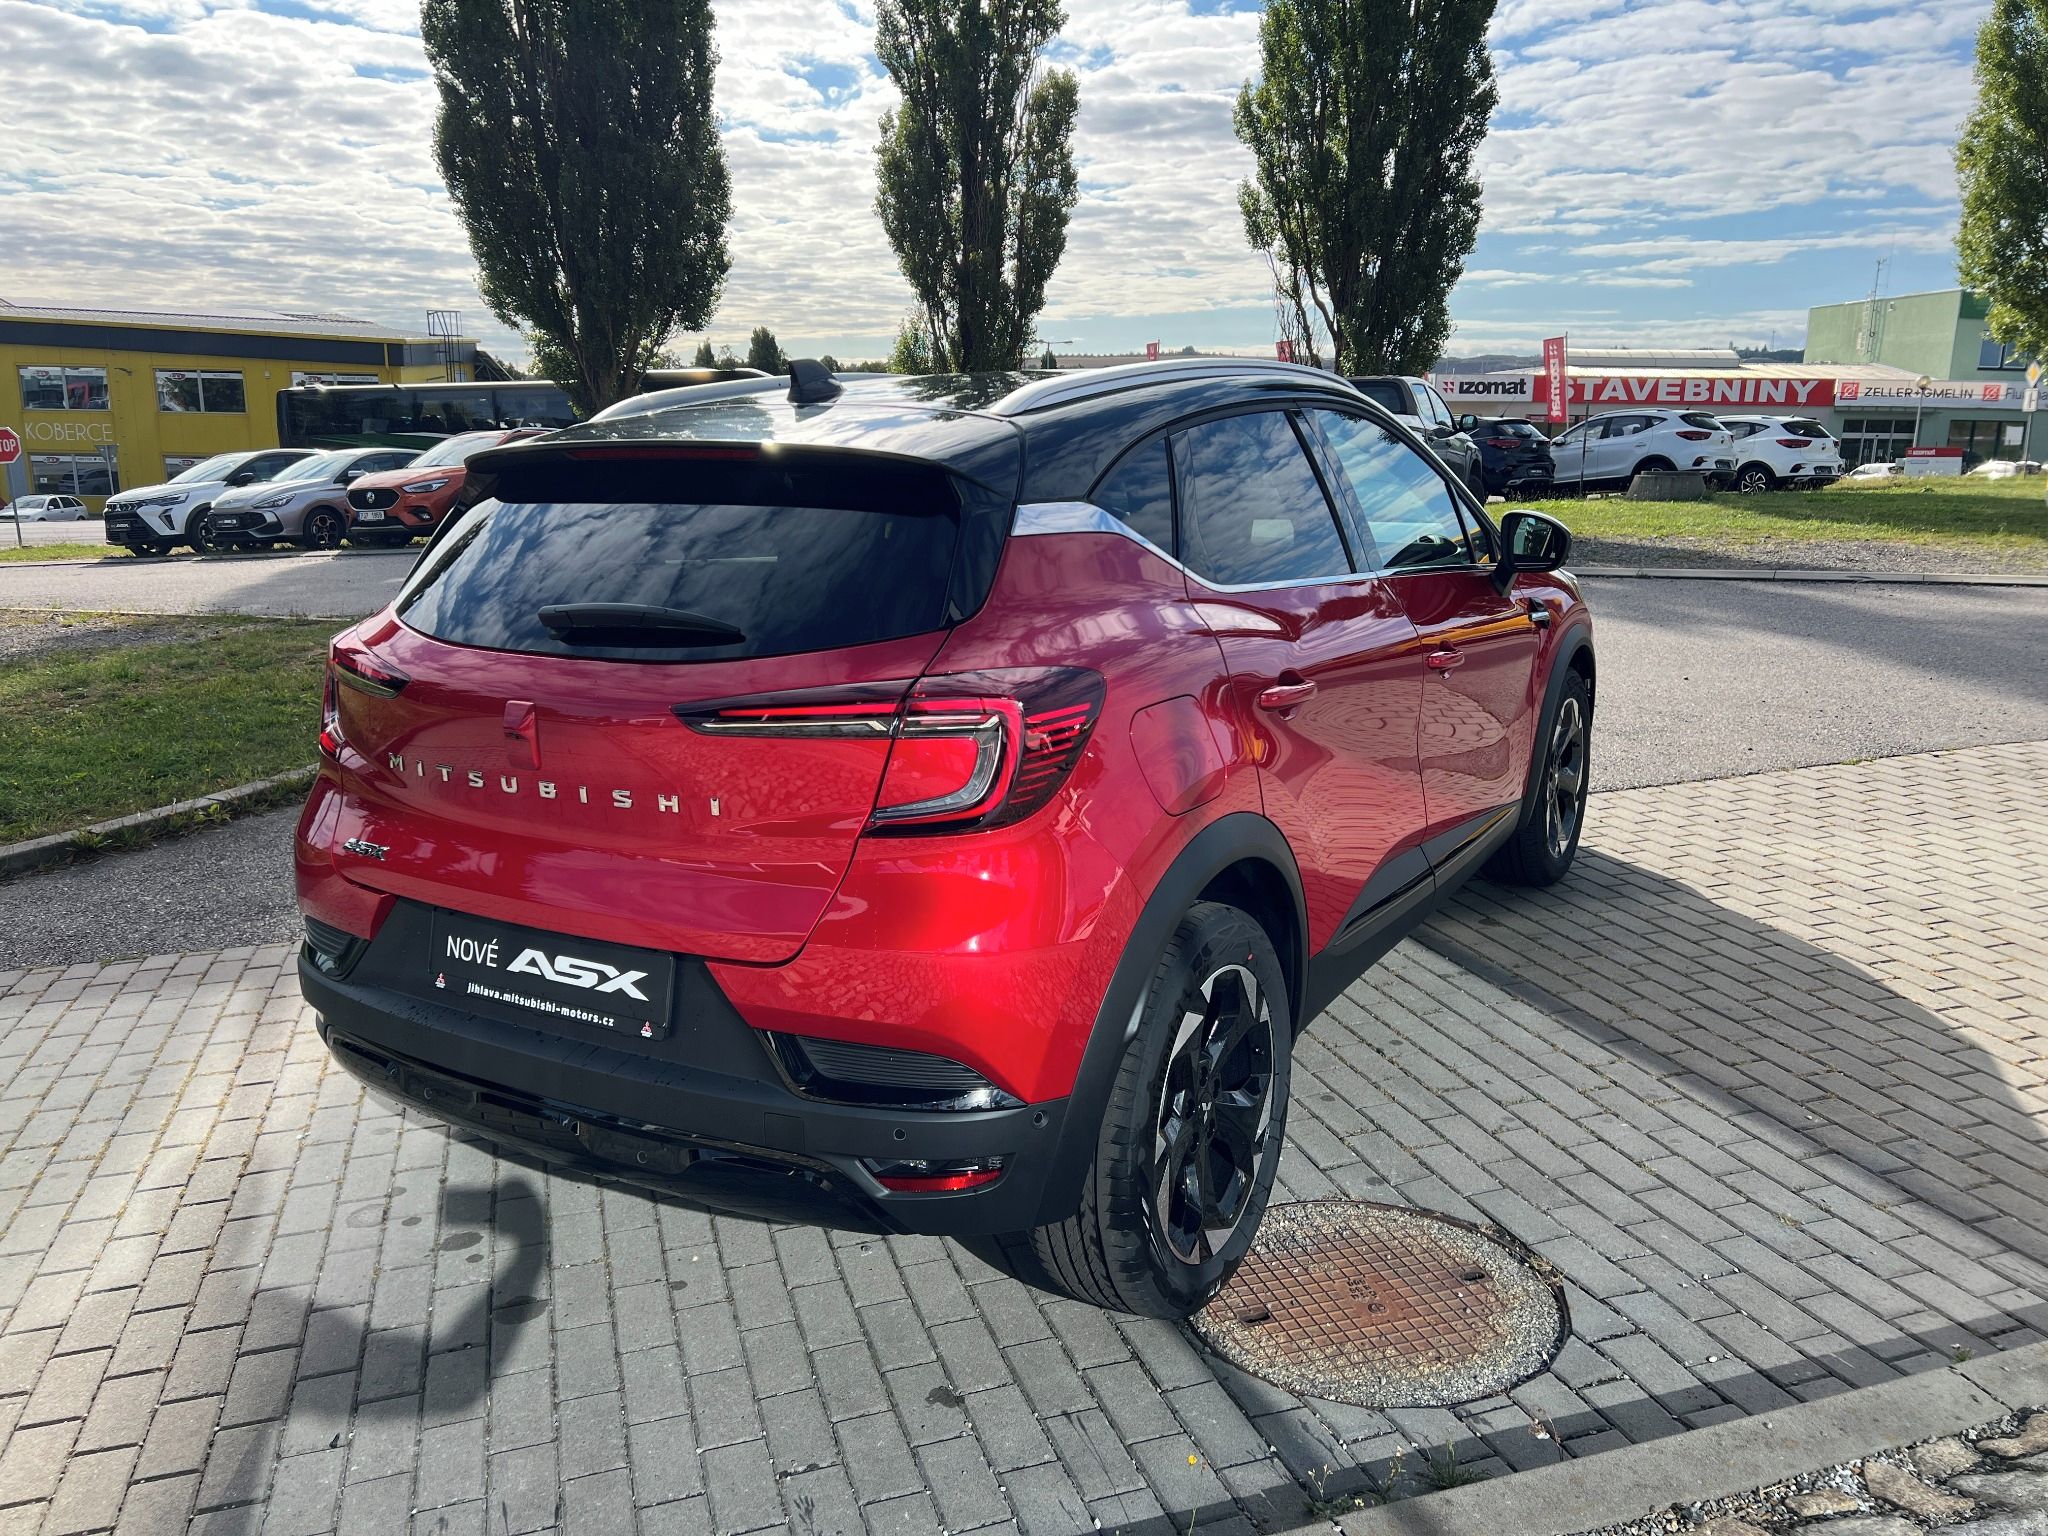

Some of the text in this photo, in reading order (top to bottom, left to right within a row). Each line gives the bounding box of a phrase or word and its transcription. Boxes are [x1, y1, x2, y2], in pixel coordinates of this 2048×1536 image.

[1458, 378, 1527, 395] izomat
[1864, 386, 1974, 399] ZELLER+GMELIN
[24, 422, 113, 441] KOBERCE
[0, 439, 16, 453] TOP
[388, 751, 722, 817] MITSUBISHI
[446, 935, 650, 1002] NOVÉ ASX
[466, 982, 615, 1027] jihlava.mitsubishi-motors.cz
